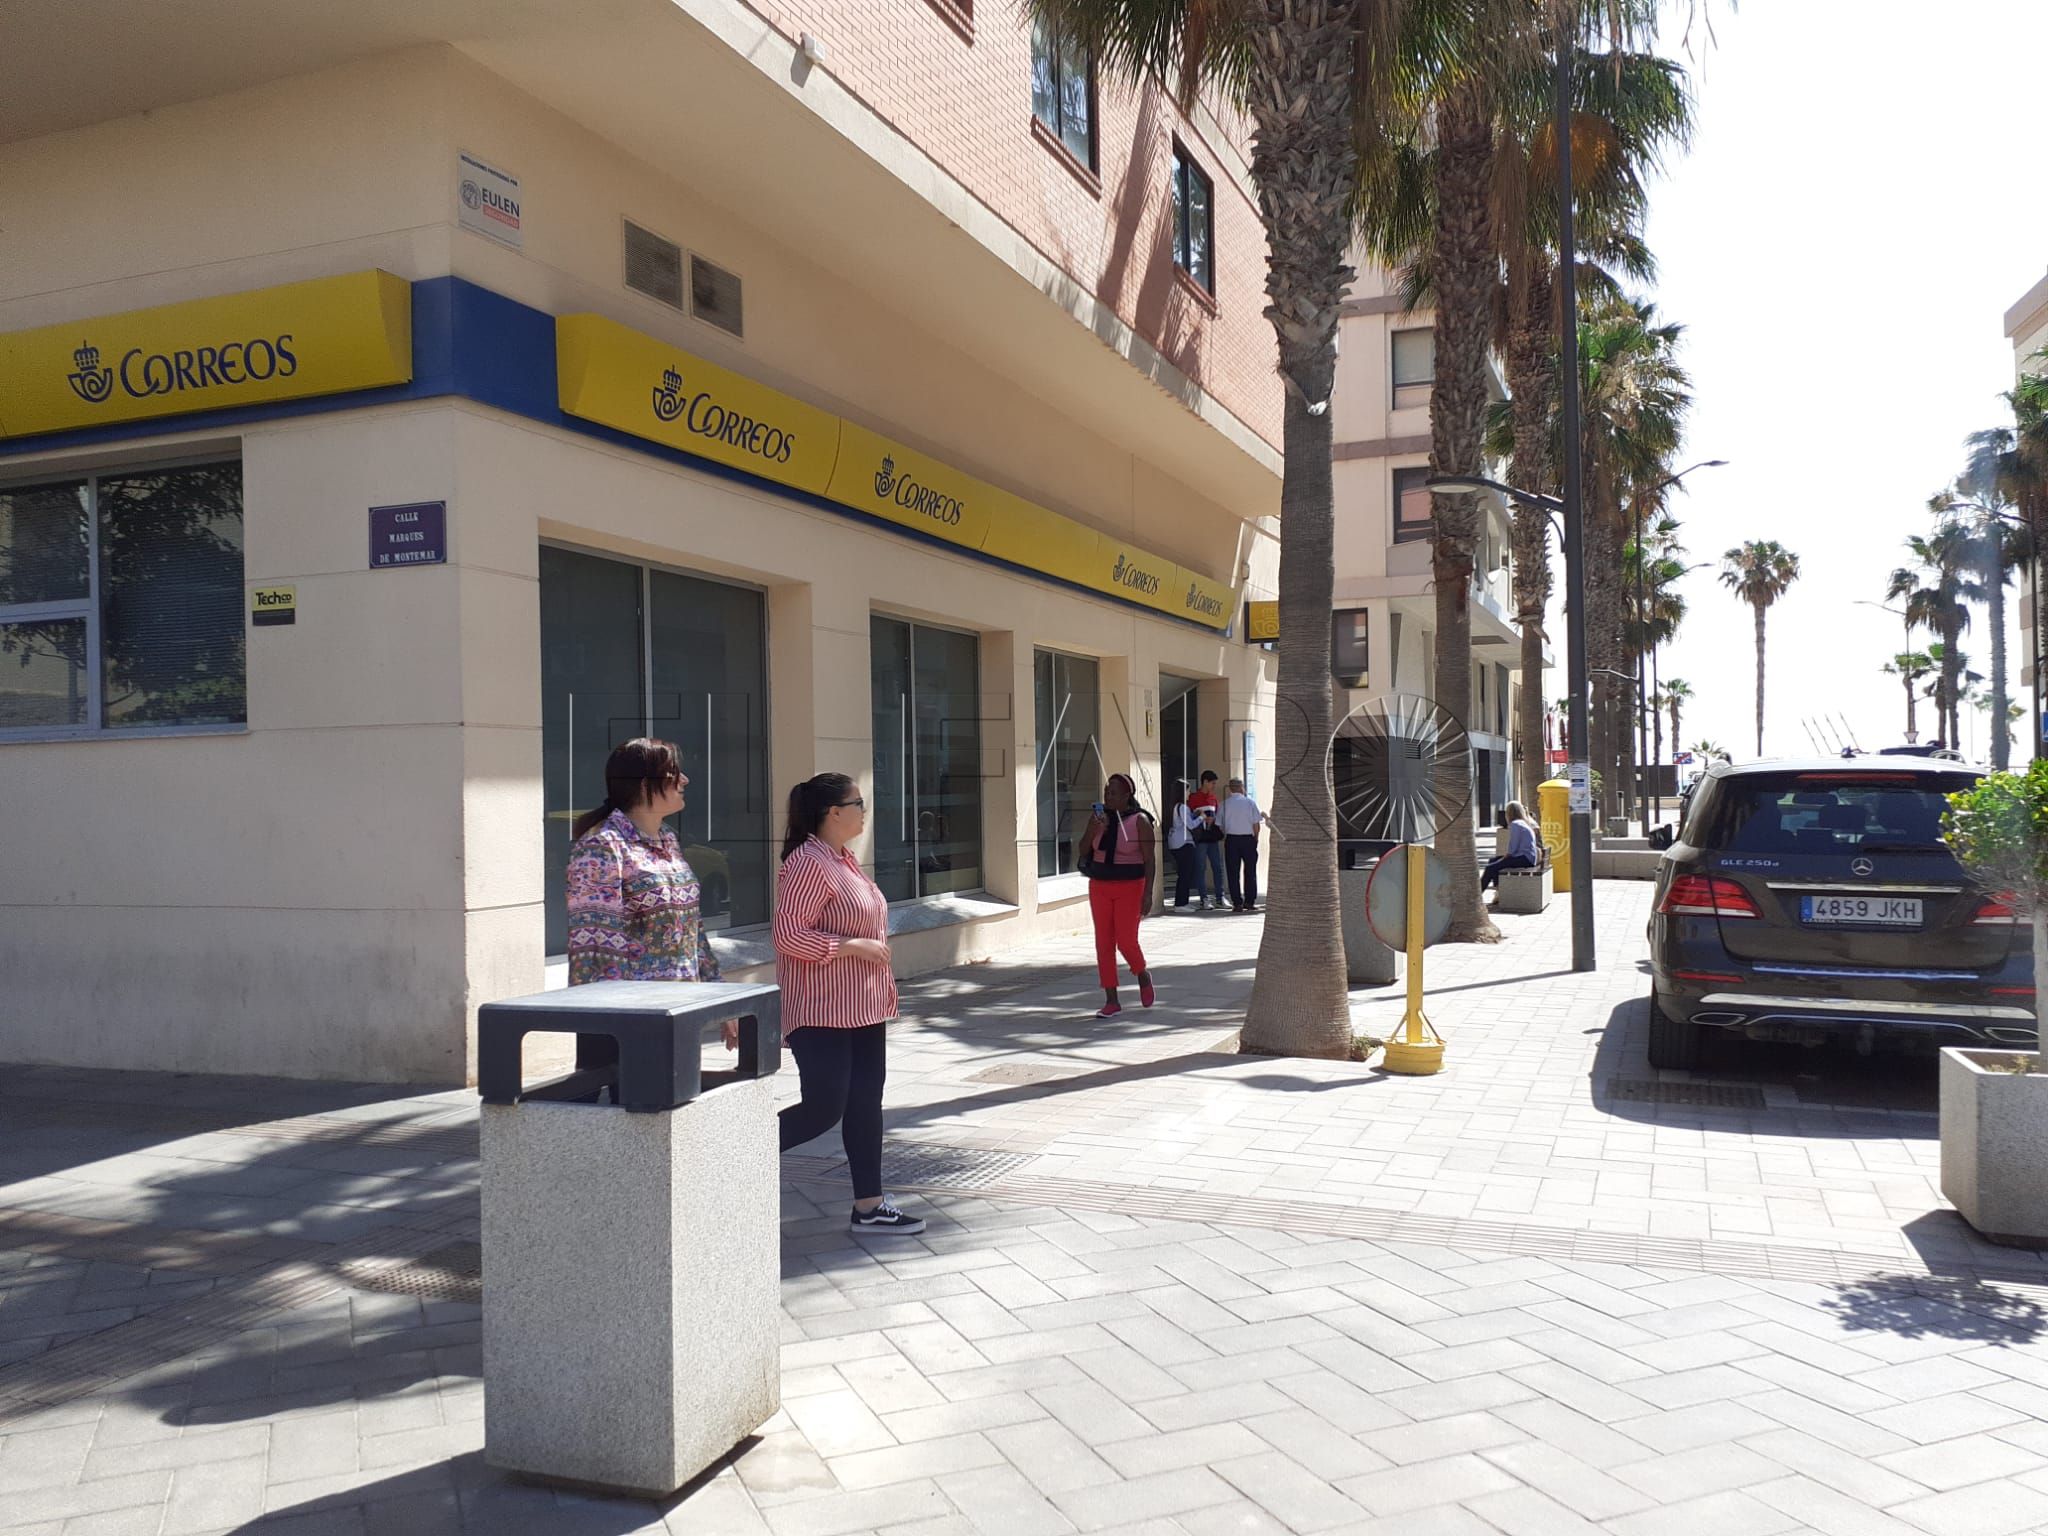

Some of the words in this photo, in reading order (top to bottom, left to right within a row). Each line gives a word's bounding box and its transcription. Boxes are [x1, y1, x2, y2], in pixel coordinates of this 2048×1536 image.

[482, 188, 520, 218] EULEN
[119, 334, 297, 398] CORREOS
[687, 393, 796, 464] CORREOS
[894, 474, 965, 526] CORREOS
[395, 512, 419, 523] CALLE
[389, 532, 424, 543] MARQUES
[379, 553, 390, 564] DE
[394, 551, 436, 562] MONTEMAR
[1122, 564, 1161, 596] CORREOS
[1194, 591, 1224, 618] CORREOS
[1720, 858, 1744, 867] GLE
[1746, 858, 1780, 868] 250d
[1815, 900, 1869, 918] 4859
[1876, 901, 1917, 919] JKH
